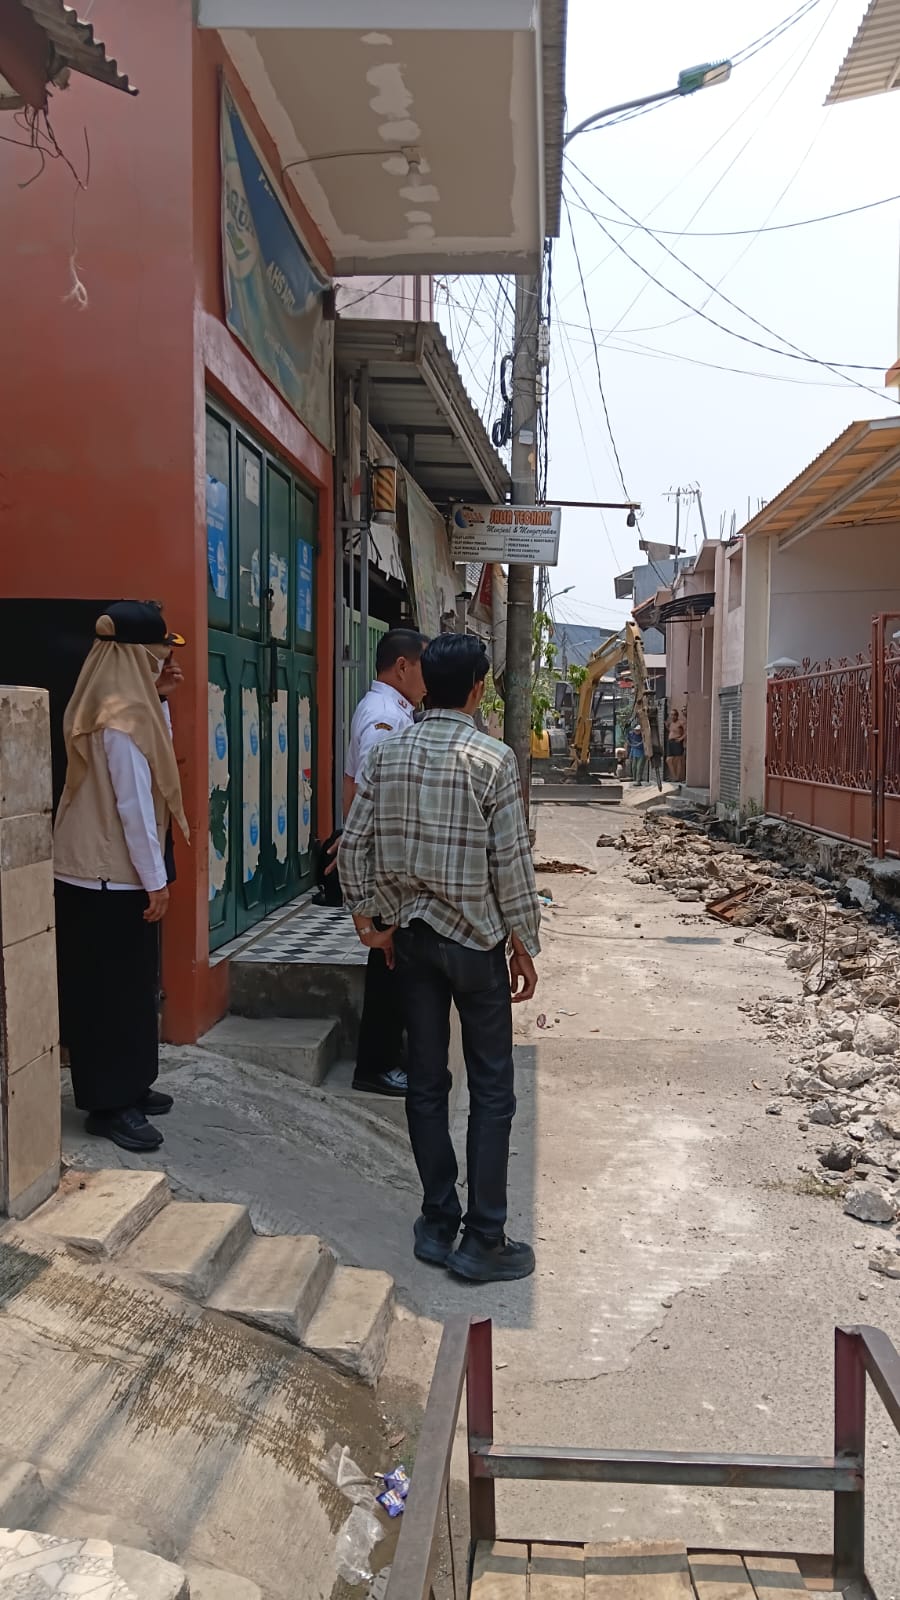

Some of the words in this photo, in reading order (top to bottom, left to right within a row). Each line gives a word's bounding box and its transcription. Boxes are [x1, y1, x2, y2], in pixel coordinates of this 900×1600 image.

[514, 510, 552, 526] TECHNIK
[486, 525, 511, 535] Menjual
[512, 526, 518, 534] &
[518, 525, 557, 537] Mengerjakan
